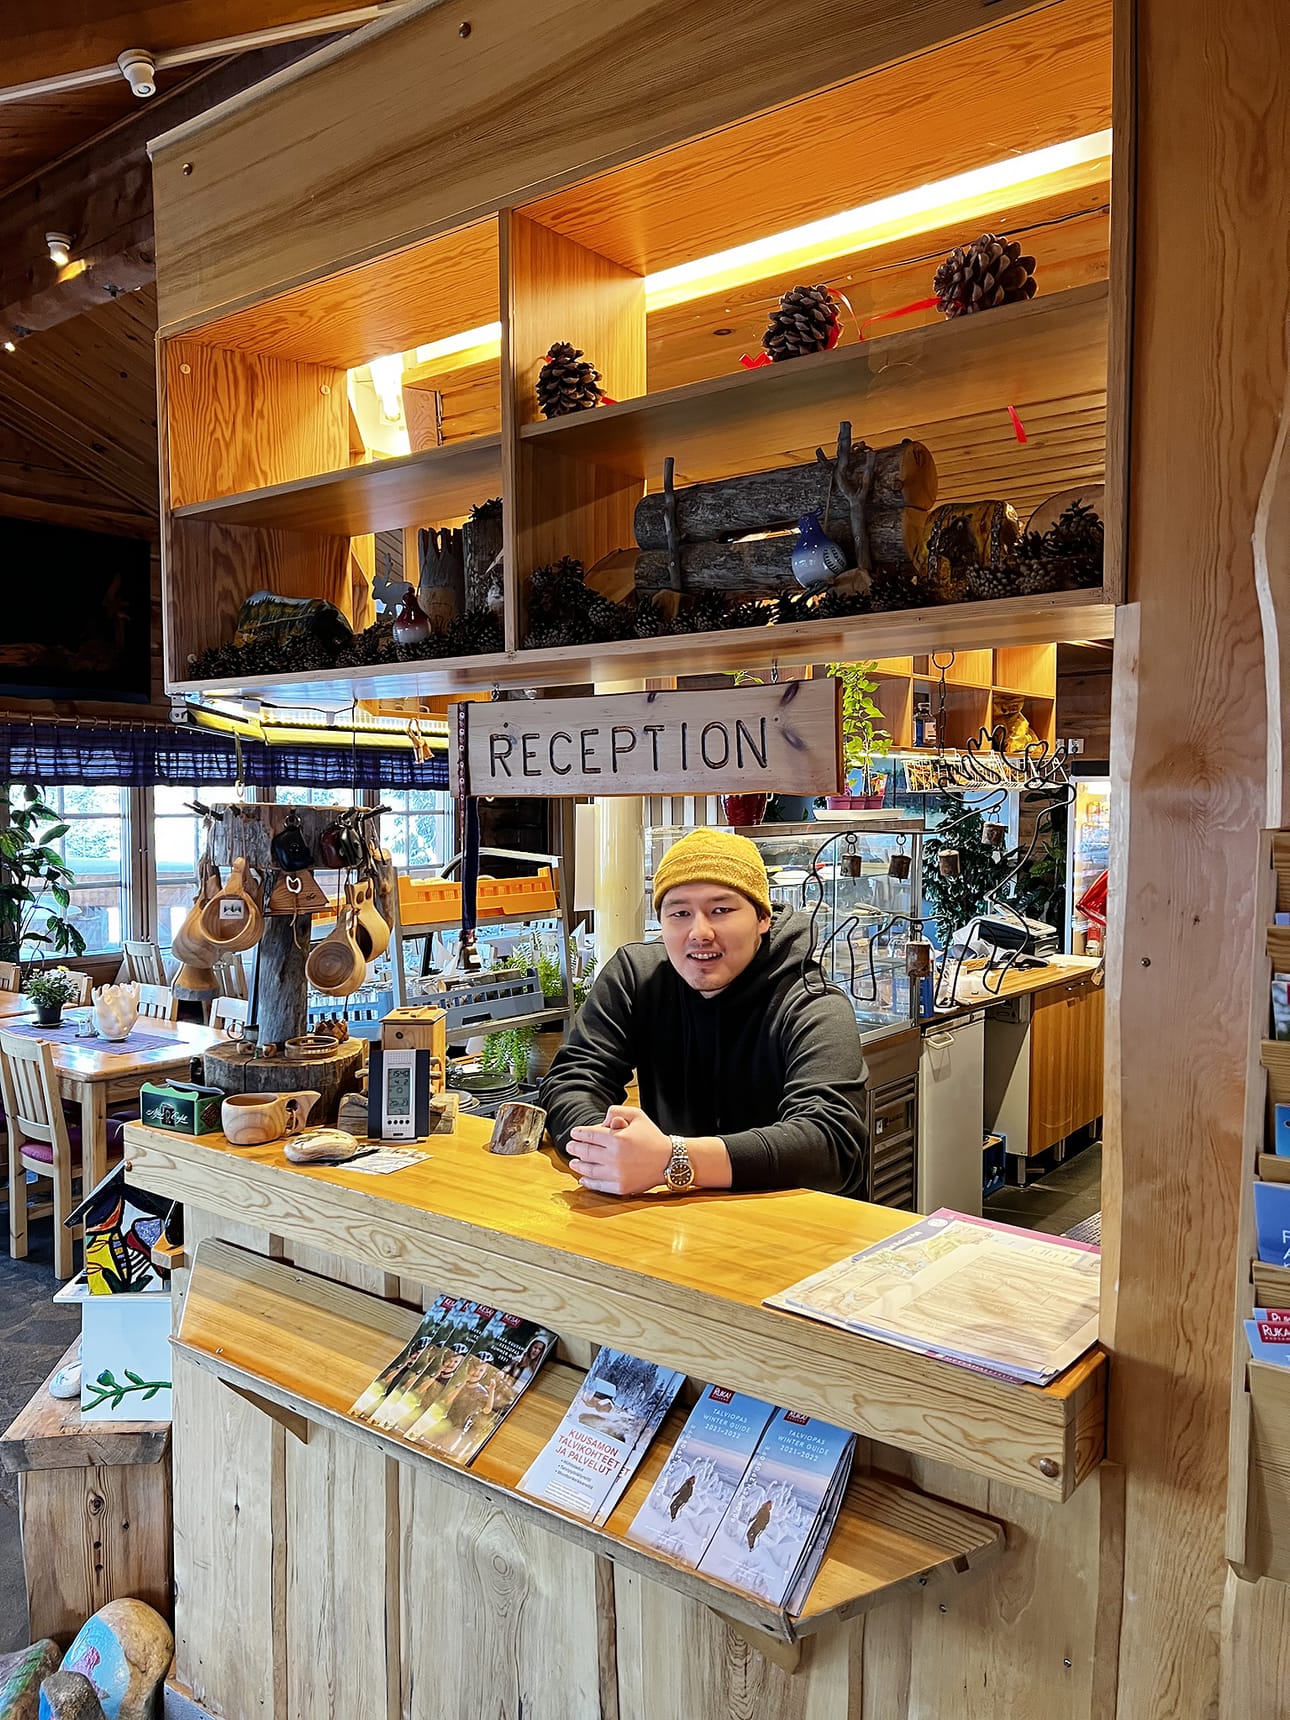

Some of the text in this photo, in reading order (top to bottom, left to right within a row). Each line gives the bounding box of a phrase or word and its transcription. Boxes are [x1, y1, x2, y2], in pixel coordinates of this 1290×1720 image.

[489, 717, 768, 777] RECEPTION
[703, 1414, 751, 1433] WINTER GUIDE
[713, 1408, 748, 1424] TALVIOPAS
[568, 1428, 619, 1457] KUUSAMON
[778, 1435, 829, 1456] WINTER GUIDE
[788, 1430, 825, 1445] TALVIOPAS
[555, 1446, 566, 1456] JA
[568, 1450, 612, 1476] PALVELUT
[558, 1434, 620, 1469] TALVIKOHTEET
